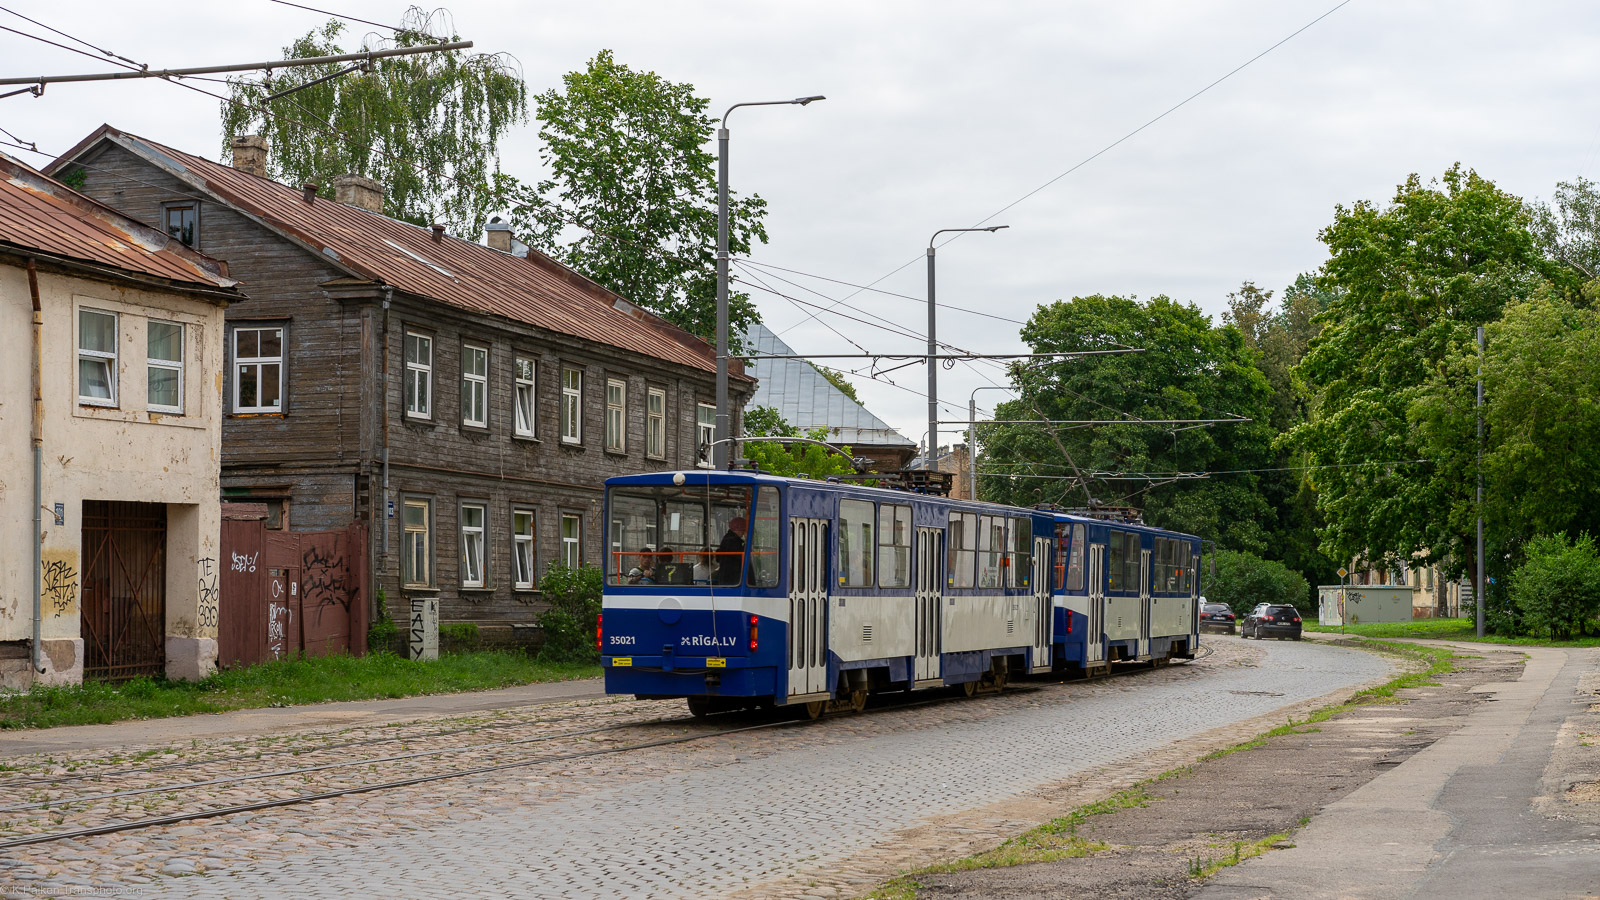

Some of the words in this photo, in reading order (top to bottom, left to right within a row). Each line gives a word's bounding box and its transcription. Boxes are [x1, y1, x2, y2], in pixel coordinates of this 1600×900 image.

[410, 600, 425, 661] EASY
[610, 636, 636, 645] 35021
[692, 635, 737, 646] RĪGA.LV
